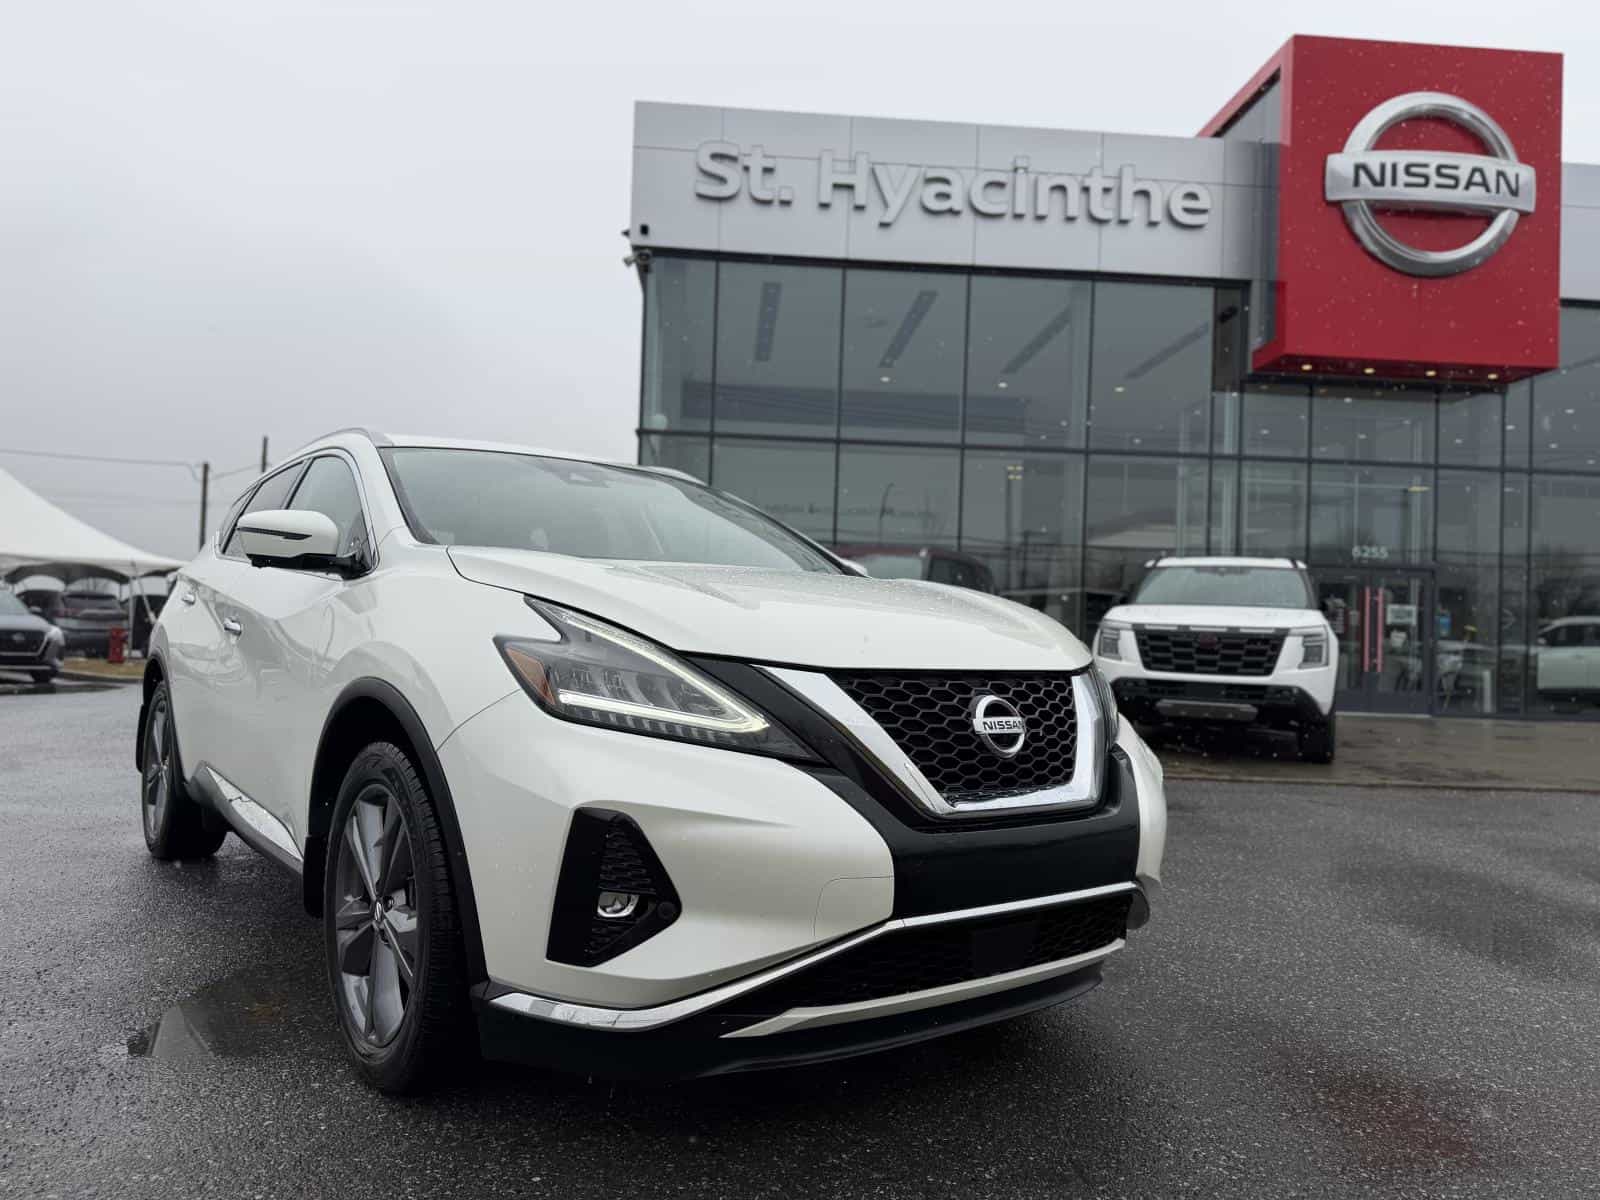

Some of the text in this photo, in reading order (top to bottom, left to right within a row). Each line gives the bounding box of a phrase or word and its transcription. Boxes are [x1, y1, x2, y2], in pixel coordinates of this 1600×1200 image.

[696, 140, 1212, 230] St. Hyacinthe
[1352, 161, 1520, 198] NISSAN
